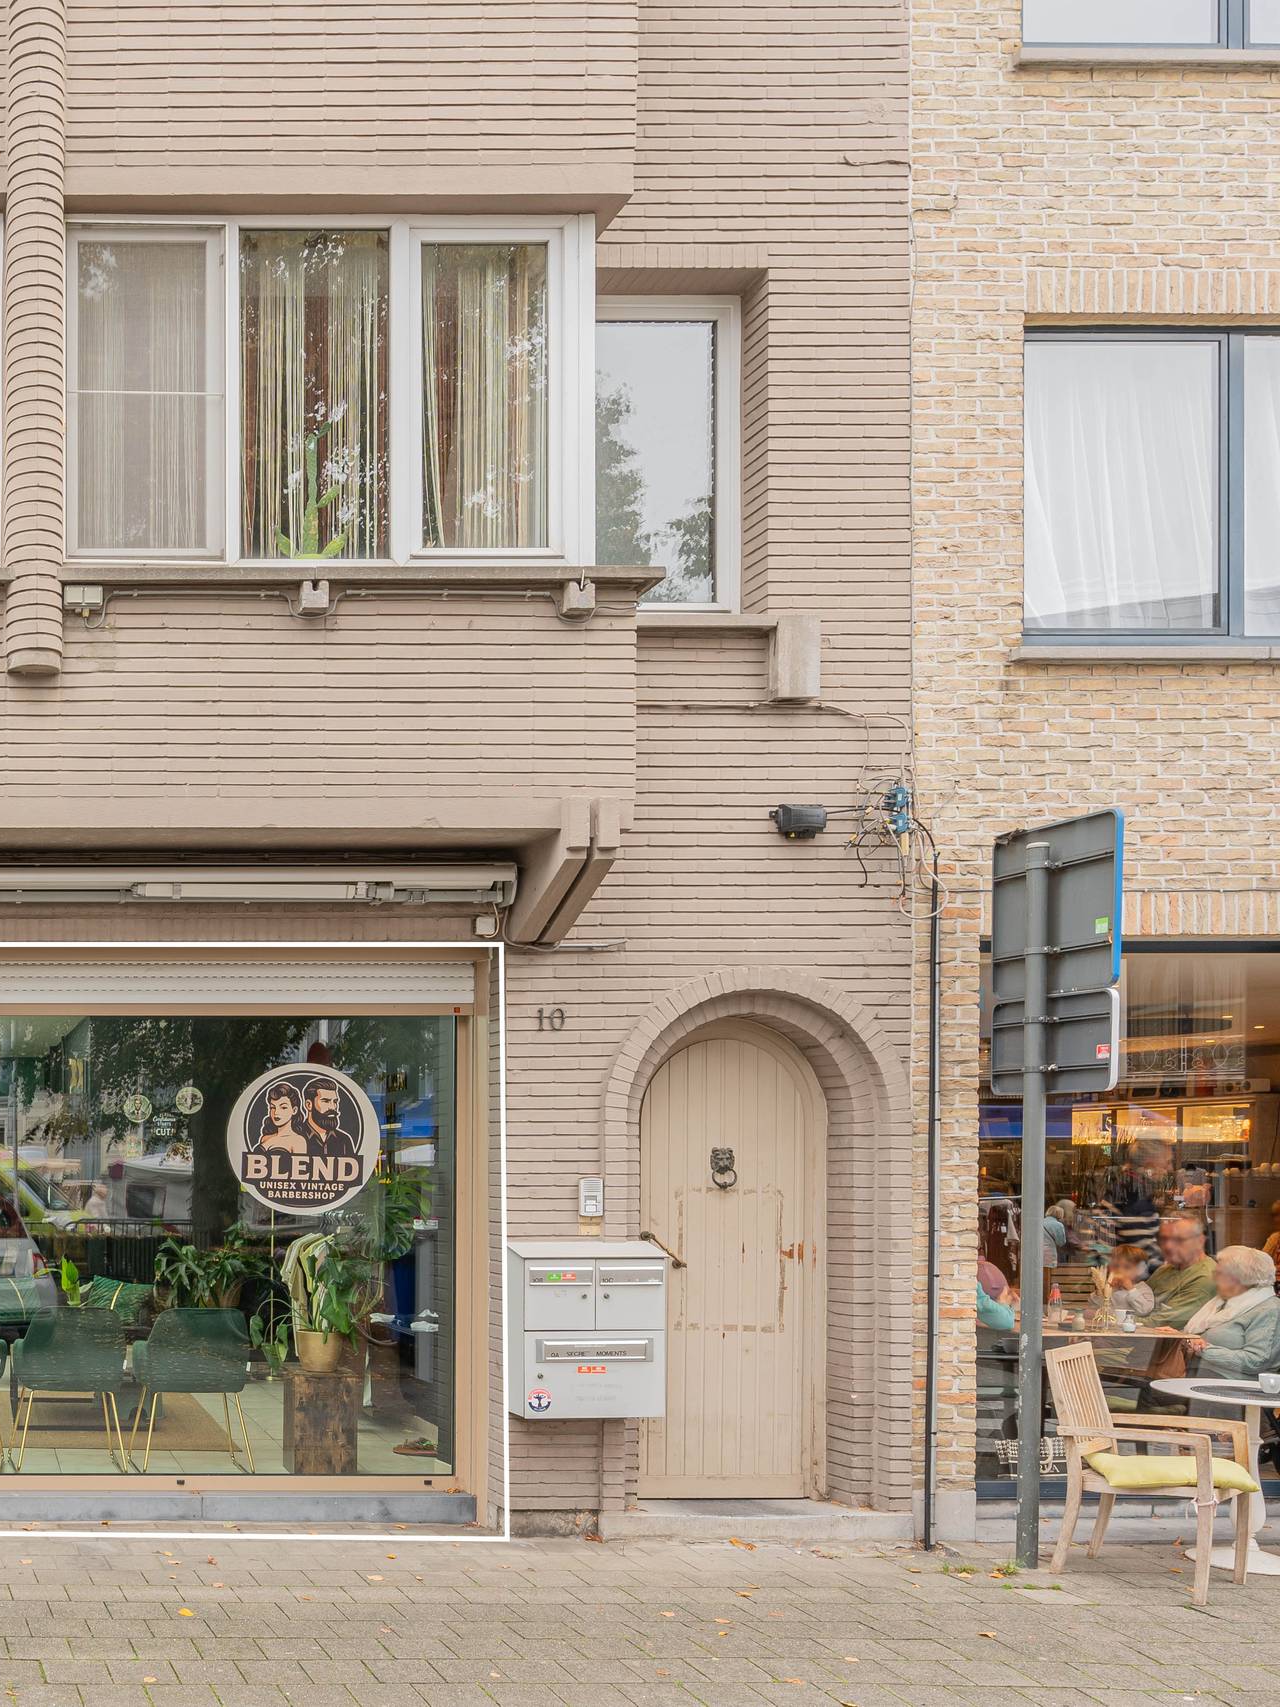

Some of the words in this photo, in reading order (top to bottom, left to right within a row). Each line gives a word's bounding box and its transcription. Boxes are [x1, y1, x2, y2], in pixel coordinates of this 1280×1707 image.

[536, 1007, 566, 1032] 10
[245, 1154, 360, 1182] BLEND
[259, 1181, 297, 1190] UNISEX
[300, 1182, 345, 1191] VINTAGE
[267, 1190, 336, 1200] BARBERSHOP
